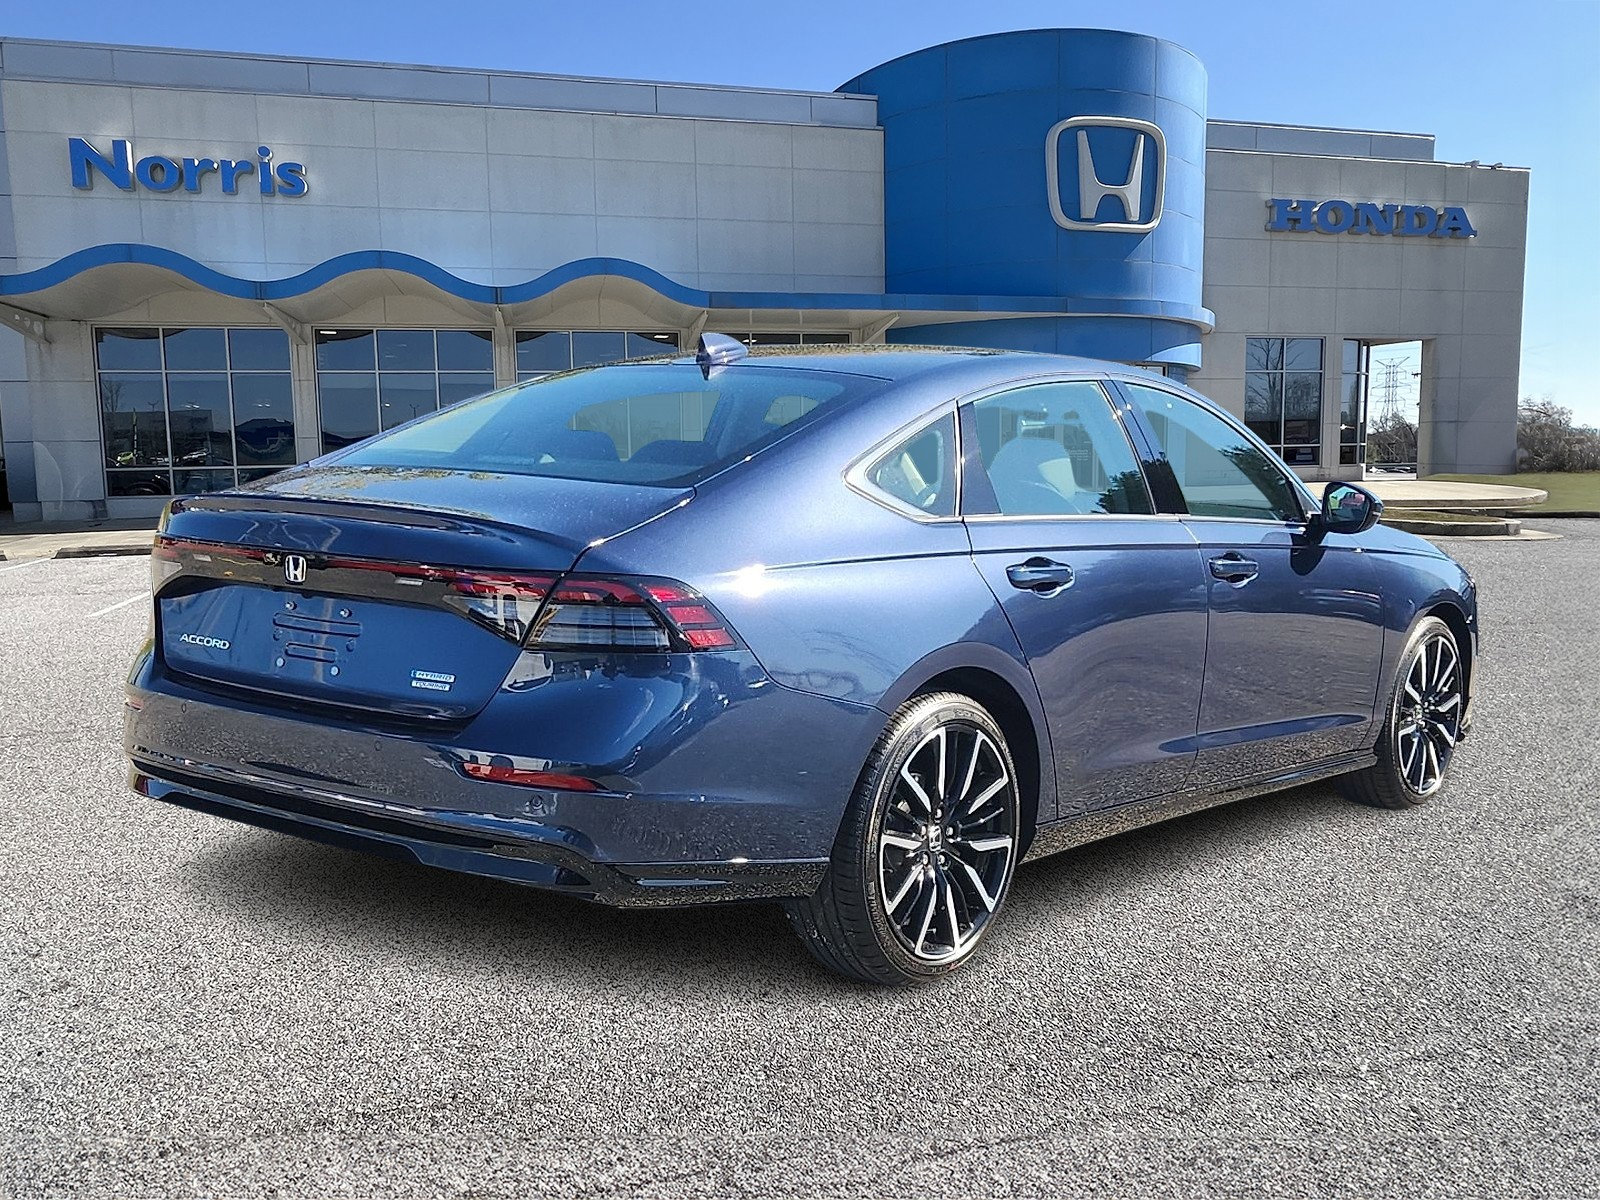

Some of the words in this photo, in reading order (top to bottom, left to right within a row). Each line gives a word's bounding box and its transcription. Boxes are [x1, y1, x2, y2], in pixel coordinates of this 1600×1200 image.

[68, 137, 308, 197] Norris
[1266, 198, 1478, 239] HONDA
[179, 633, 231, 650] ACCORD
